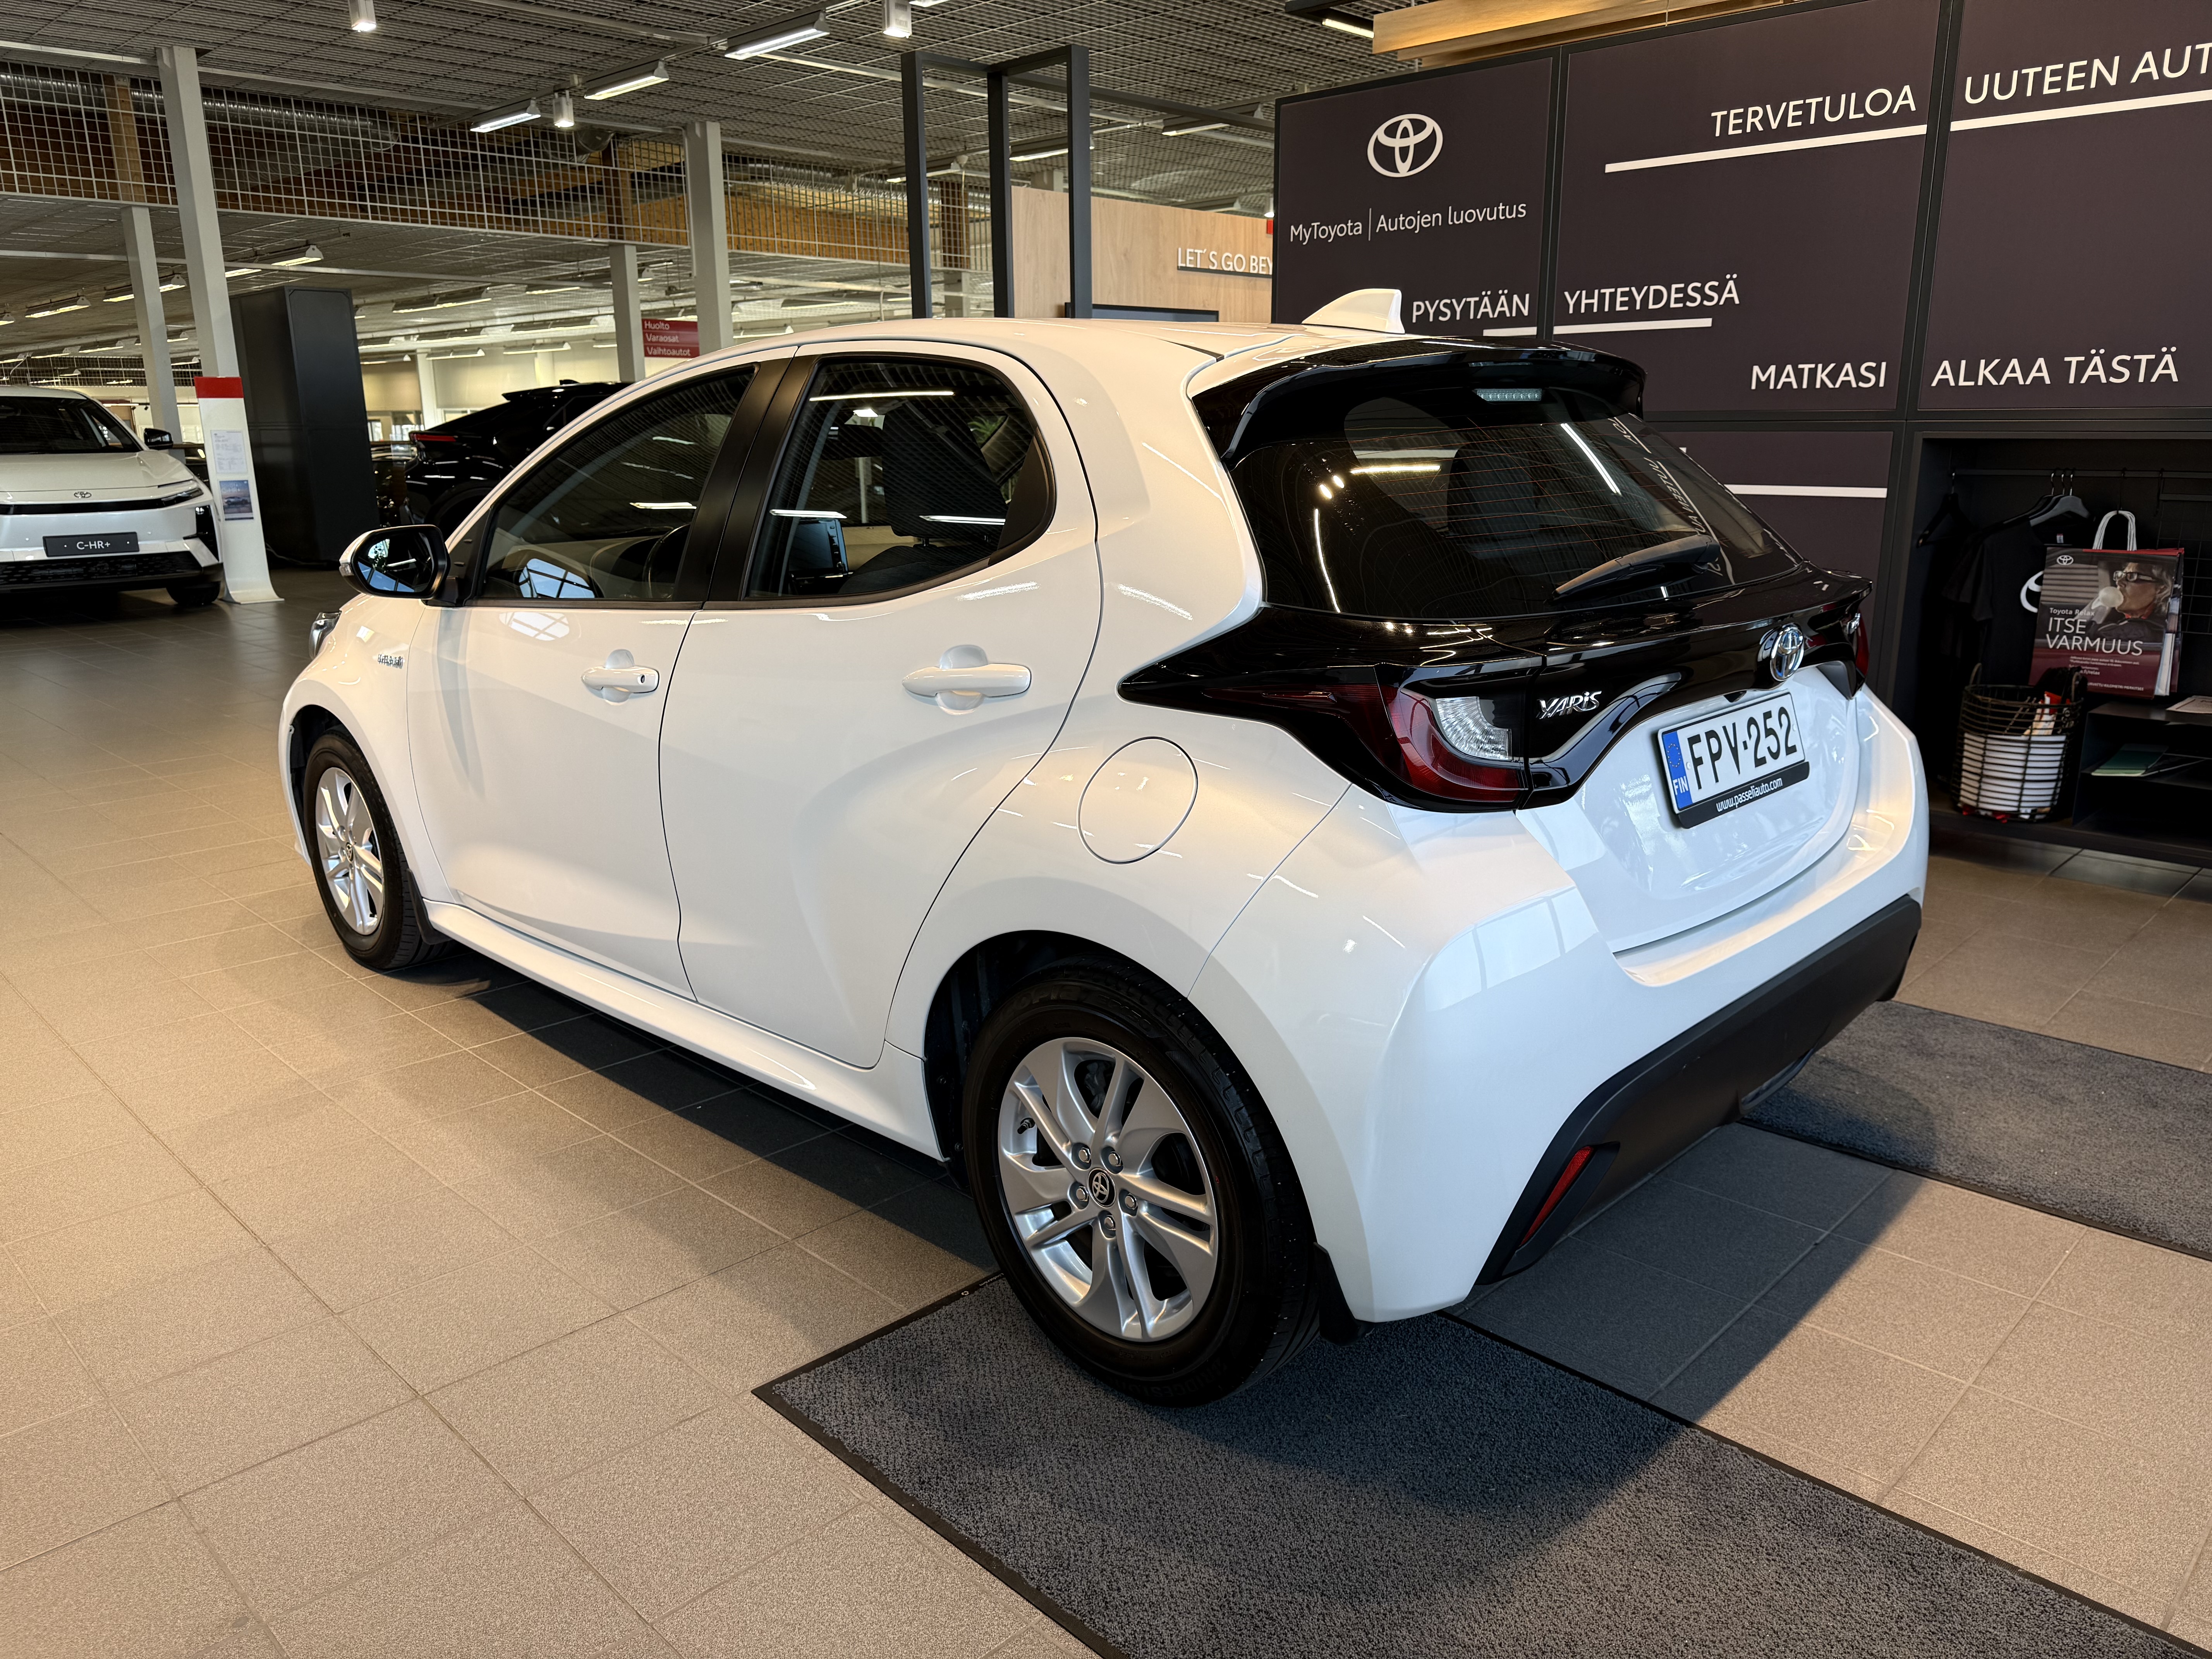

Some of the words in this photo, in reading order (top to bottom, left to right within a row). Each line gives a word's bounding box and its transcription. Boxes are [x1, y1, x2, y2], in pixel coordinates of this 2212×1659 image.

[1711, 85, 1916, 137] TERVETULOA
[1965, 56, 2120, 104] UUTEEN
[2130, 43, 2212, 83] AUT
[1290, 220, 1362, 245] MyToyota
[1376, 210, 1442, 233] Autojen
[1448, 203, 1527, 225] luovutus
[1221, 252, 1246, 272] GO
[1412, 290, 1529, 323] PYSYTÄÄN
[1564, 274, 1740, 314] YHTEYDESSÄ
[644, 320, 670, 330] Huolto
[645, 333, 680, 343] Varaosat
[646, 347, 691, 356] Vaihtoautot
[1751, 362, 1886, 390] MATKASI
[1931, 358, 2051, 387] ALKAA
[2064, 346, 2179, 384] TÄSTÄ
[77, 541, 110, 550] C-HR+
[2048, 617, 2087, 634] ITSE
[2046, 634, 2143, 656] VARMUUS
[1536, 691, 1602, 719] YARIS
[1687, 706, 1798, 790] FPV-252
[1673, 776, 1689, 795] FIN
[1716, 778, 1783, 812] www.passeliauto.com
